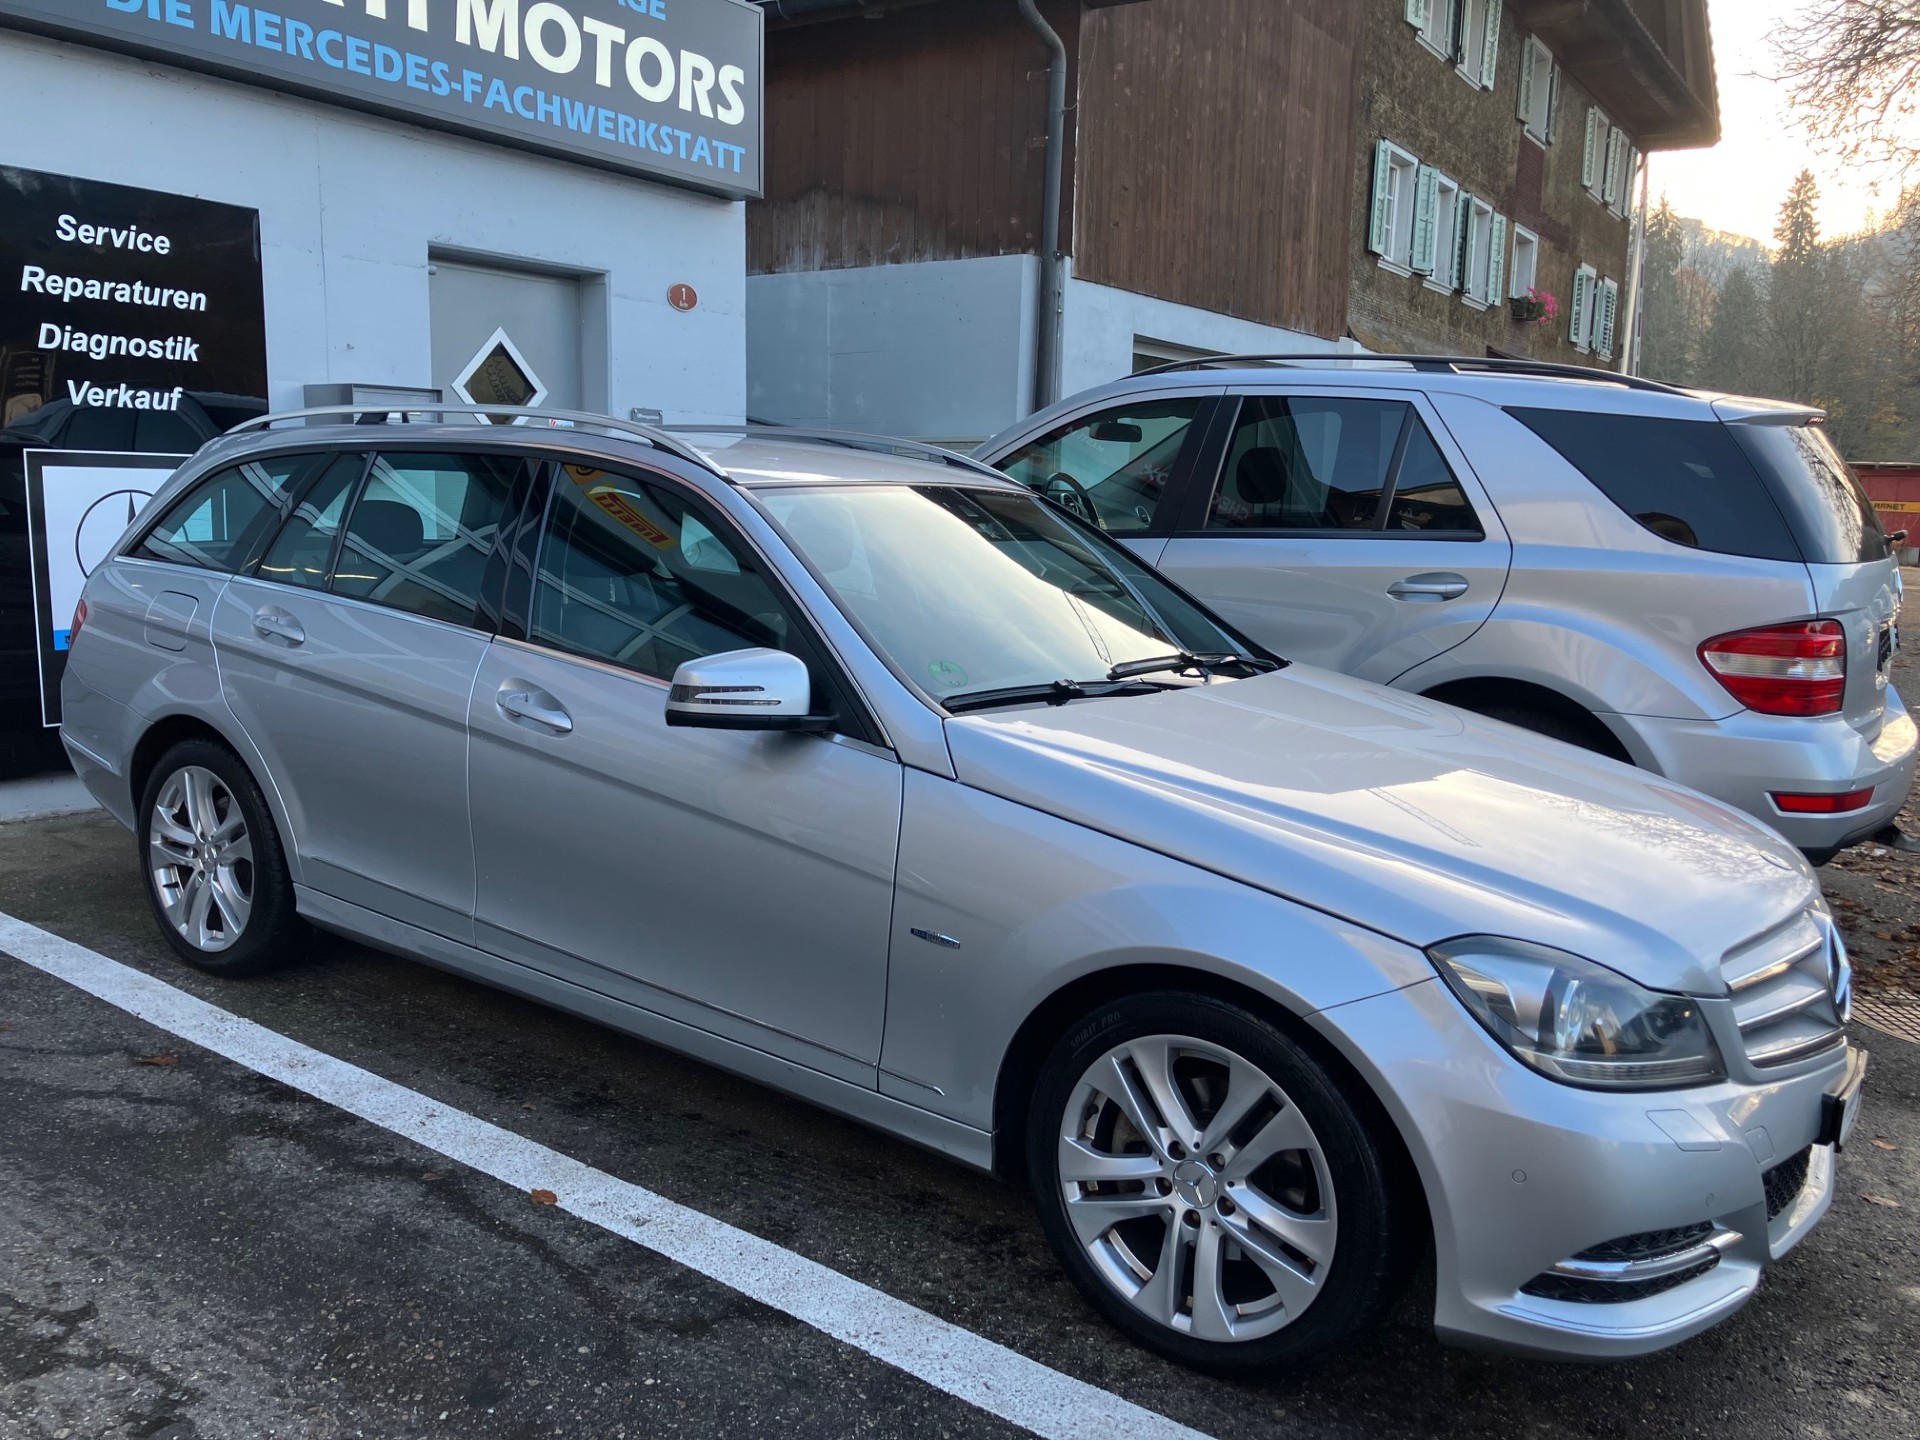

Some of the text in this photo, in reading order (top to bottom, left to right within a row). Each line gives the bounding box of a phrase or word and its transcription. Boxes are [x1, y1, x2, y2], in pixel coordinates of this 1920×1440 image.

[455, 0, 745, 126] MOTORS
[210, 0, 746, 174] MERCEDES-FACHWERKSTATT
[55, 213, 171, 255] Service
[20, 264, 207, 311] Reparaturen
[37, 322, 200, 362] Diagnostik
[66, 379, 183, 411] Verkauf
[1101, 1011, 1120, 1028] PRO
